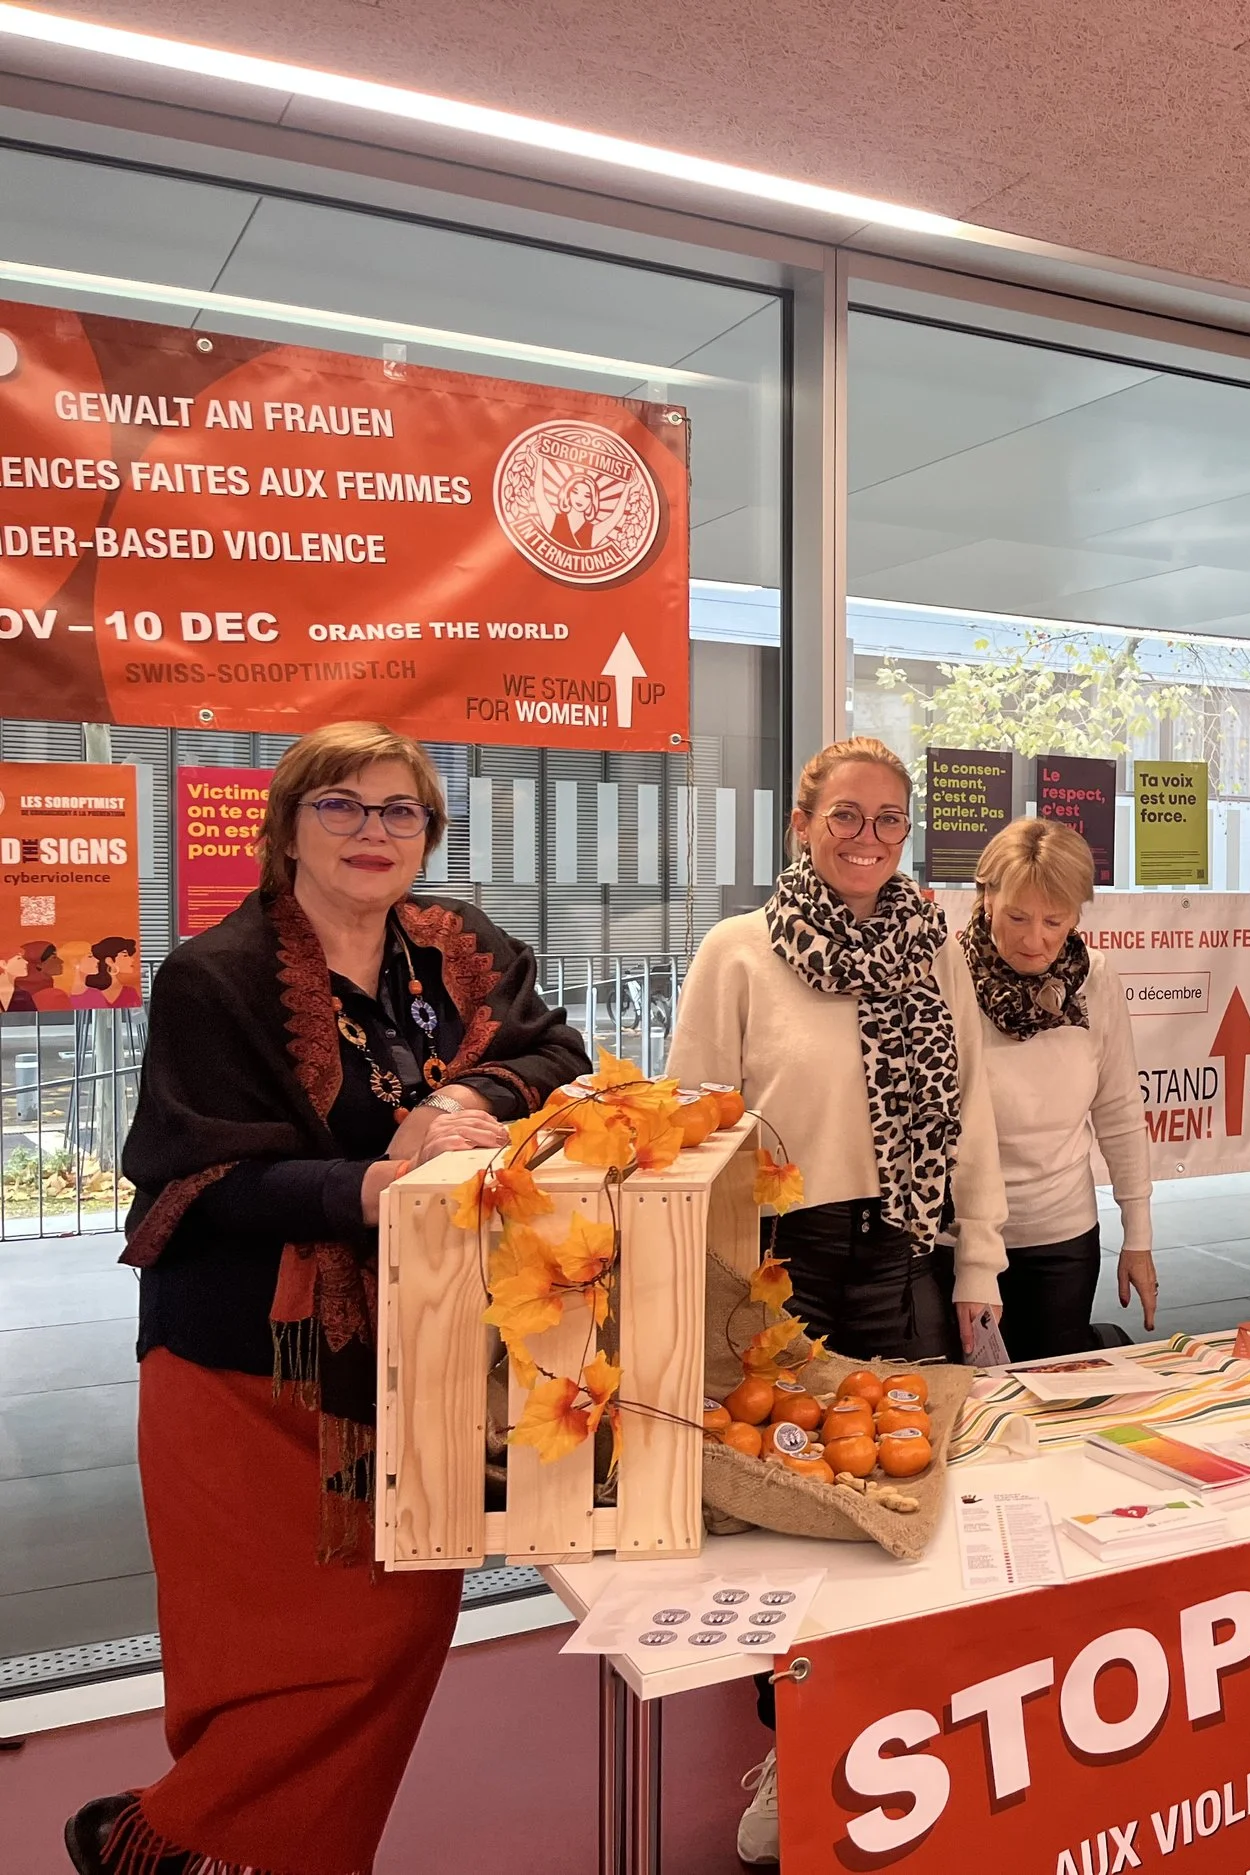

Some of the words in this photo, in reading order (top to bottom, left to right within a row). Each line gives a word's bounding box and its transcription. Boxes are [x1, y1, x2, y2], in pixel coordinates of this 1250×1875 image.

[55, 390, 194, 427] GEWALT
[205, 400, 254, 430] AN
[263, 402, 394, 438] FRAUEN
[541, 438, 633, 479] SOROPTIMIST
[0, 457, 120, 491] ENCES
[131, 461, 250, 496] FAITES
[260, 467, 328, 499] AUX
[336, 471, 472, 504] FEMMES
[0, 526, 214, 560] DER-BASED
[223, 530, 386, 563] VIOLENCE
[516, 520, 624, 573] INTERNATIONAL
[0, 607, 58, 641] OV
[105, 610, 163, 642] 10
[180, 611, 280, 642] DEC
[308, 623, 422, 642] ORANGE
[429, 622, 481, 640] THE
[486, 623, 569, 640] WORLD
[125, 660, 416, 684] SWISS-SOROPTIMIST.CH
[503, 673, 536, 699] WE
[541, 677, 612, 703] STAND
[637, 683, 666, 705] UP
[466, 697, 509, 722] FOR
[515, 700, 608, 728] WOMEN!
[932, 761, 949, 773] Le
[951, 763, 1006, 776] consen-
[1043, 768, 1060, 782] Le
[932, 778, 987, 792] tement,
[1140, 773, 1159, 788] Ta
[1162, 773, 1193, 788] voix
[20, 795, 42, 808] LES
[969, 794, 986, 804] en
[1042, 786, 1106, 804] respect,
[1140, 792, 1165, 805] est
[1169, 793, 1196, 806] une
[187, 805, 215, 818] on
[219, 804, 242, 819] te
[932, 807, 979, 819] parler.
[981, 807, 1004, 819] Pas
[1140, 807, 1187, 823] force.
[187, 822, 219, 837] On
[224, 824, 260, 838] est
[932, 819, 988, 832] deviner.
[40, 838, 128, 865] SIGNS
[188, 843, 240, 860] pour
[4, 872, 111, 886] cyberviolence
[1081, 930, 1146, 950] OLENCE
[1151, 930, 1193, 949] FAITE
[1199, 930, 1229, 948] AUX
[1138, 986, 1202, 1001] décembre
[1138, 1066, 1218, 1104] STAND
[1145, 1106, 1212, 1143] MEN!
[1054, 1820, 1142, 1875] AUX
